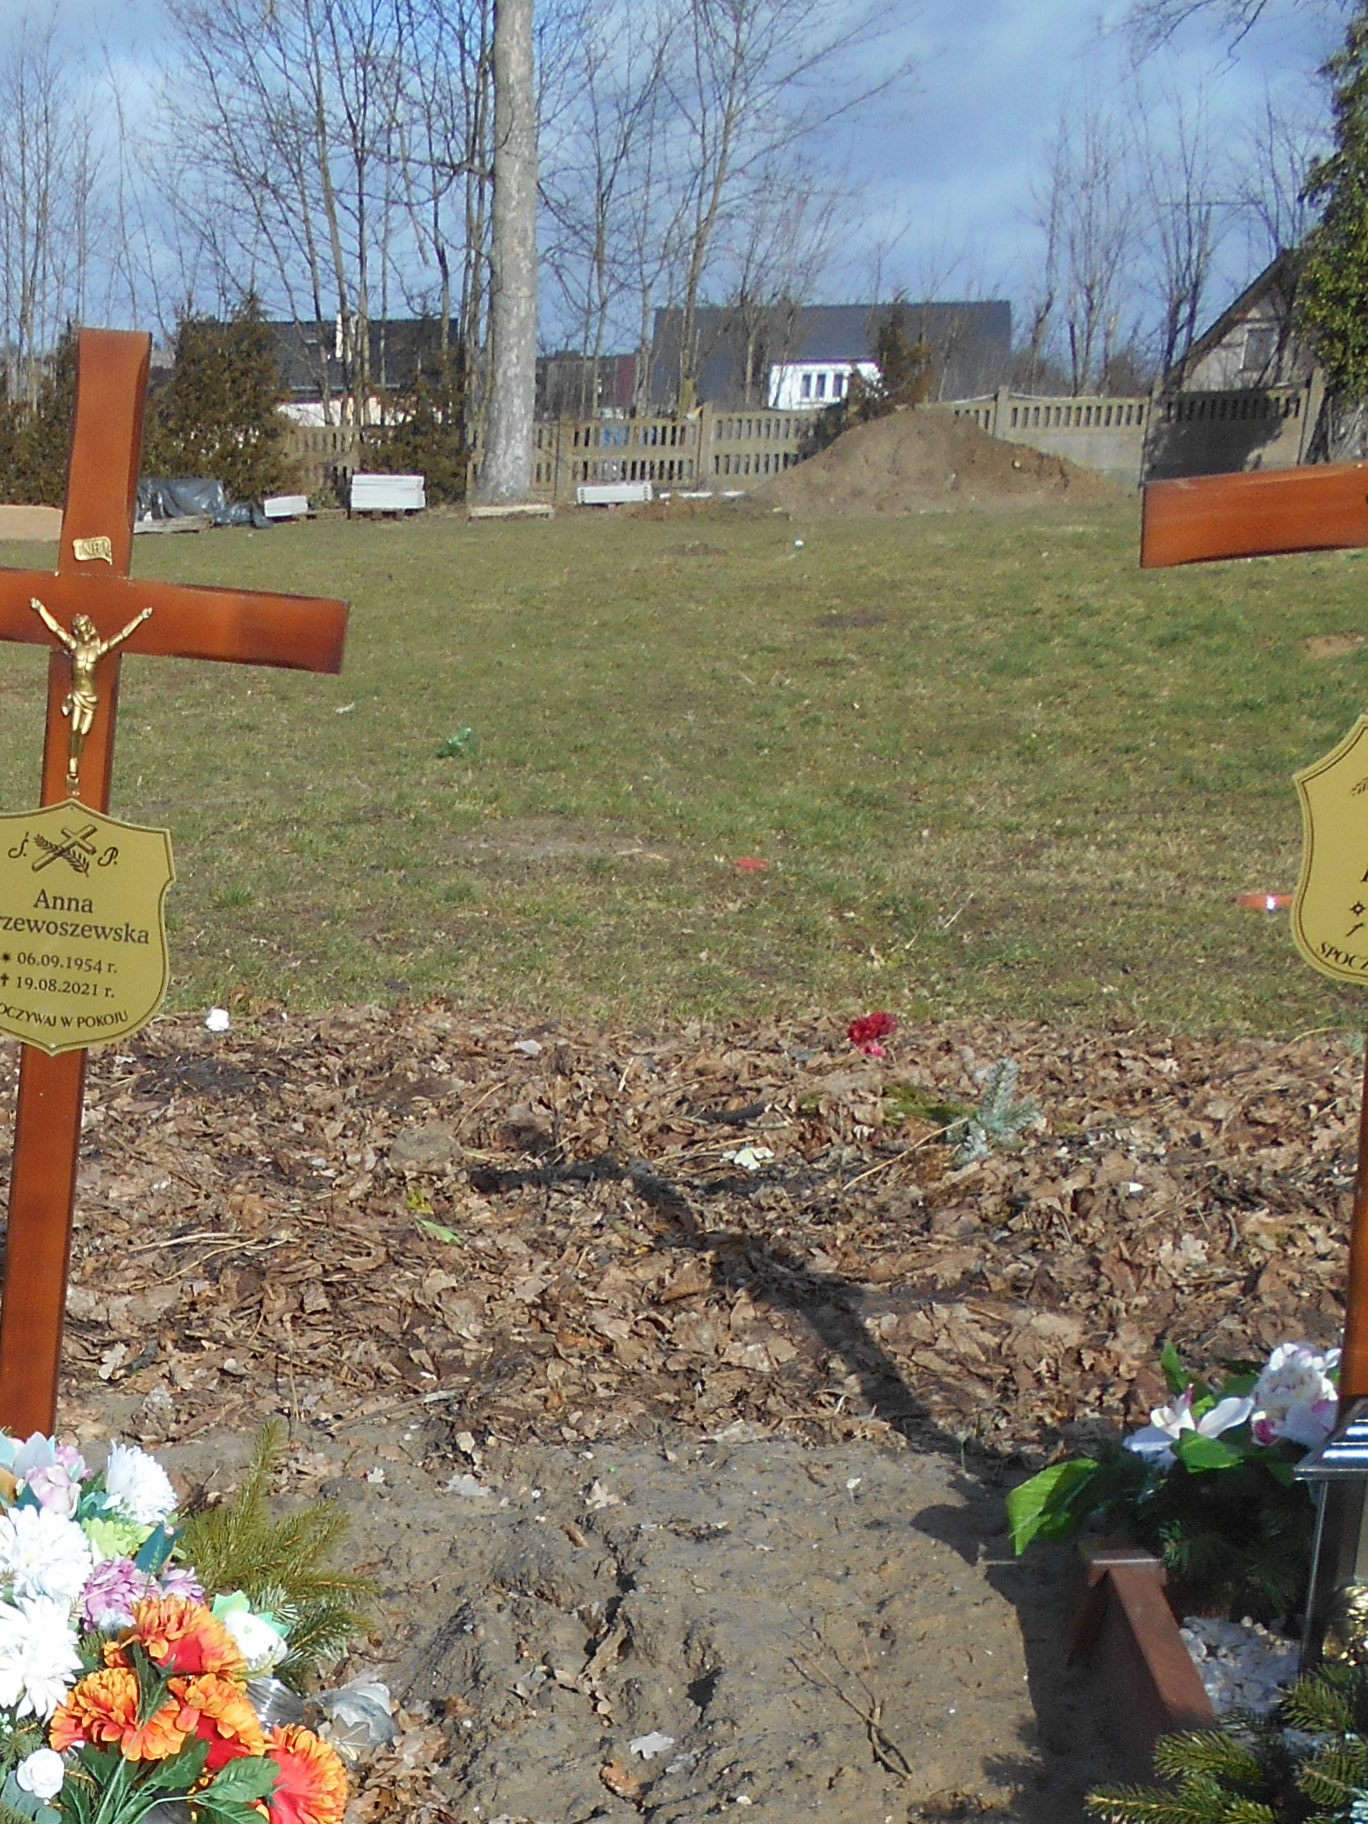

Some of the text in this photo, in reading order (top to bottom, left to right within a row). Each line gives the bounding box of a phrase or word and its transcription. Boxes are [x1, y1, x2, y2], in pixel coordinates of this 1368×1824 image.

[33, 888, 93, 914] Anna
[17, 952, 118, 974] 06.09.1954 r.
[16, 975, 116, 998] 19.08.2021 r.
[60, 1016, 73, 1027] W
[77, 1010, 129, 1028] POKOJU
